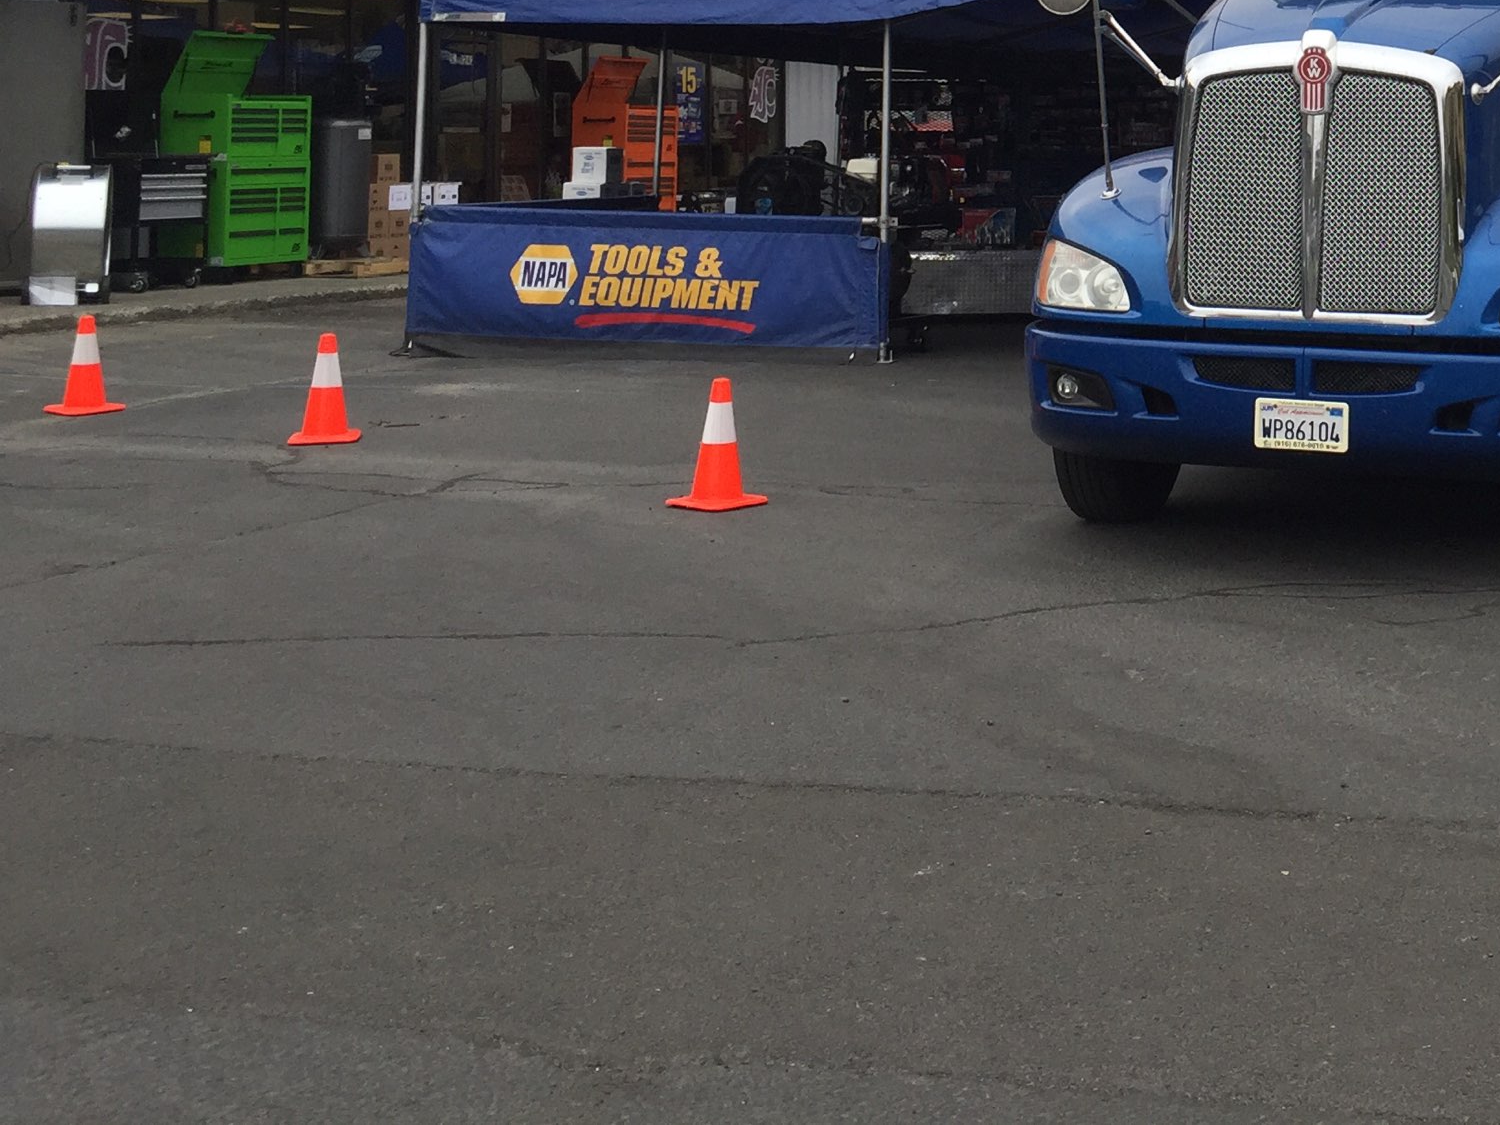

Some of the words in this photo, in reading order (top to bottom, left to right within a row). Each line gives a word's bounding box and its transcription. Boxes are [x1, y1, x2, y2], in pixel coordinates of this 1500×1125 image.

[521, 261, 567, 289] NAPA
[588, 243, 688, 277] TOOLS
[694, 247, 724, 278] &
[578, 276, 760, 311] EQUIPMENT
[1262, 418, 1340, 443] WP86104
